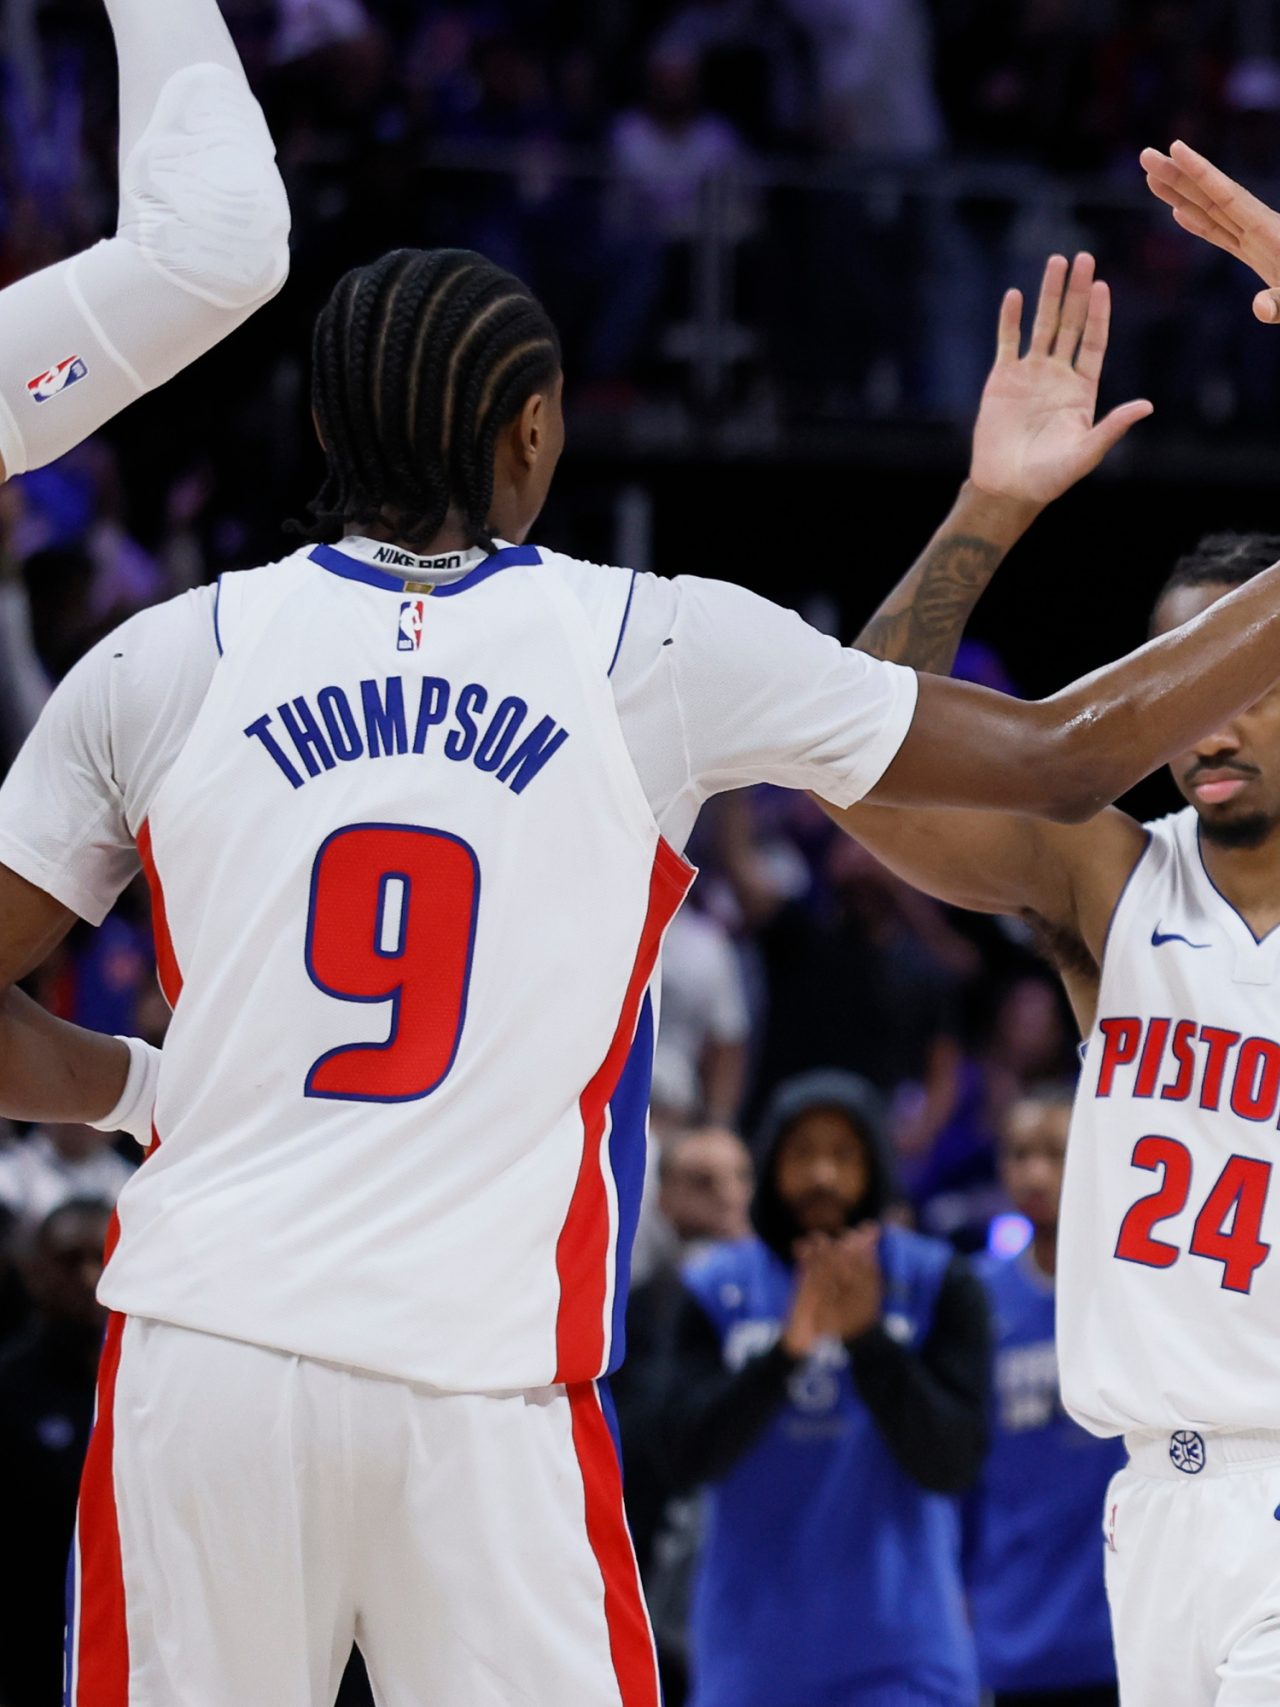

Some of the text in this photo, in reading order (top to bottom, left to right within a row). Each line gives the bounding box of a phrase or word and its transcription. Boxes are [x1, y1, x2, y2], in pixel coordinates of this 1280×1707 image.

[373, 546, 461, 569] NIKE PRO
[243, 676, 570, 795] THOMPSON
[304, 822, 481, 1104] 9
[1113, 1133, 1273, 1296] 24
